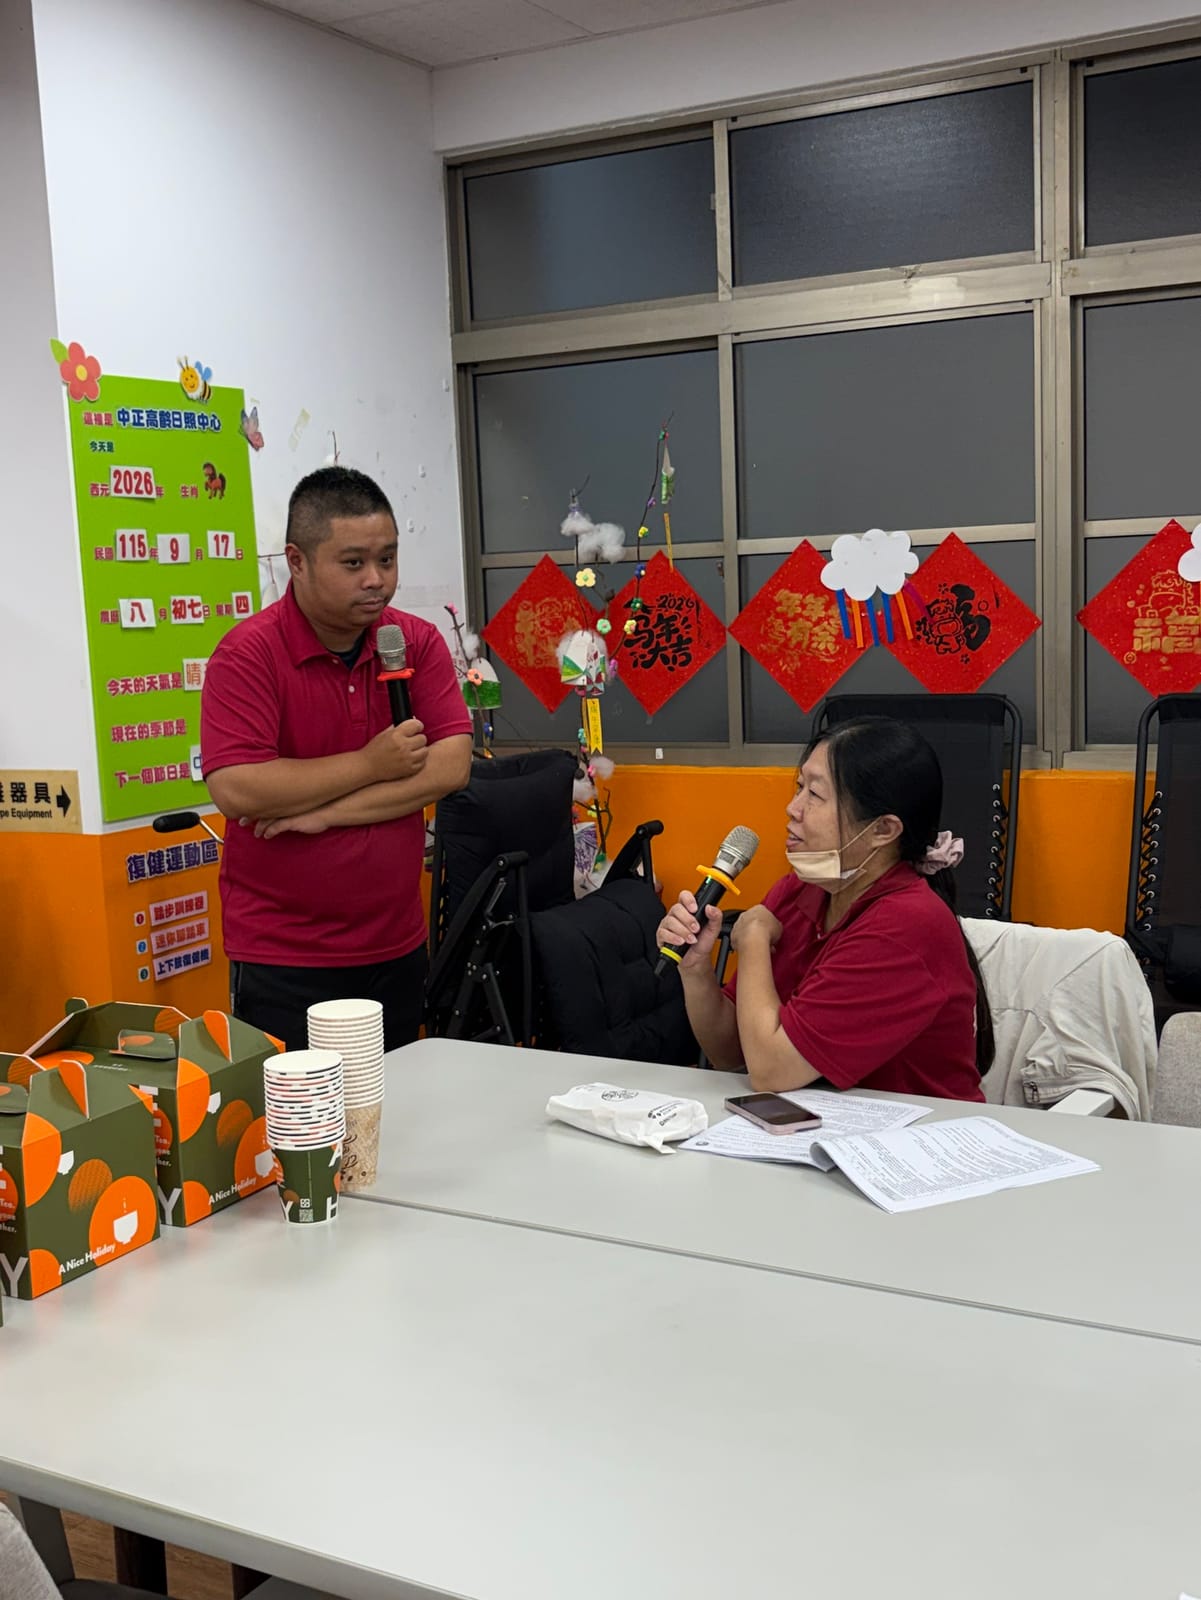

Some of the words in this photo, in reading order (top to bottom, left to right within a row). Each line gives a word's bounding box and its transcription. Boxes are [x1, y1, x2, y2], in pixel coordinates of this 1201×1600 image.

[117, 408, 221, 430] 中正高齡日照中心
[113, 469, 154, 495] 2026
[119, 534, 147, 558] 115
[170, 538, 179, 561] 9
[213, 534, 229, 557] 17
[130, 602, 146, 622] 八
[172, 598, 202, 619] 初七
[235, 595, 249, 614] 四
[656, 594, 695, 613] 2026
[107, 672, 183, 696] 今天的天氣是
[186, 662, 208, 685] 晴
[111, 718, 187, 743] 現在的季節是
[114, 762, 191, 788] 下一個節日是
[0, 782, 51, 804] 器具
[11, 808, 52, 820] Equipment
[127, 840, 218, 881] 復健運動區
[208, 1195, 215, 1206] A
[215, 1189, 231, 1201] Nice
[231, 1177, 257, 1194] Holiday
[58, 1264, 66, 1275] A
[66, 1257, 84, 1272] Nice
[85, 1243, 116, 1263] Holiday
[0, 1253, 28, 1298] Y
